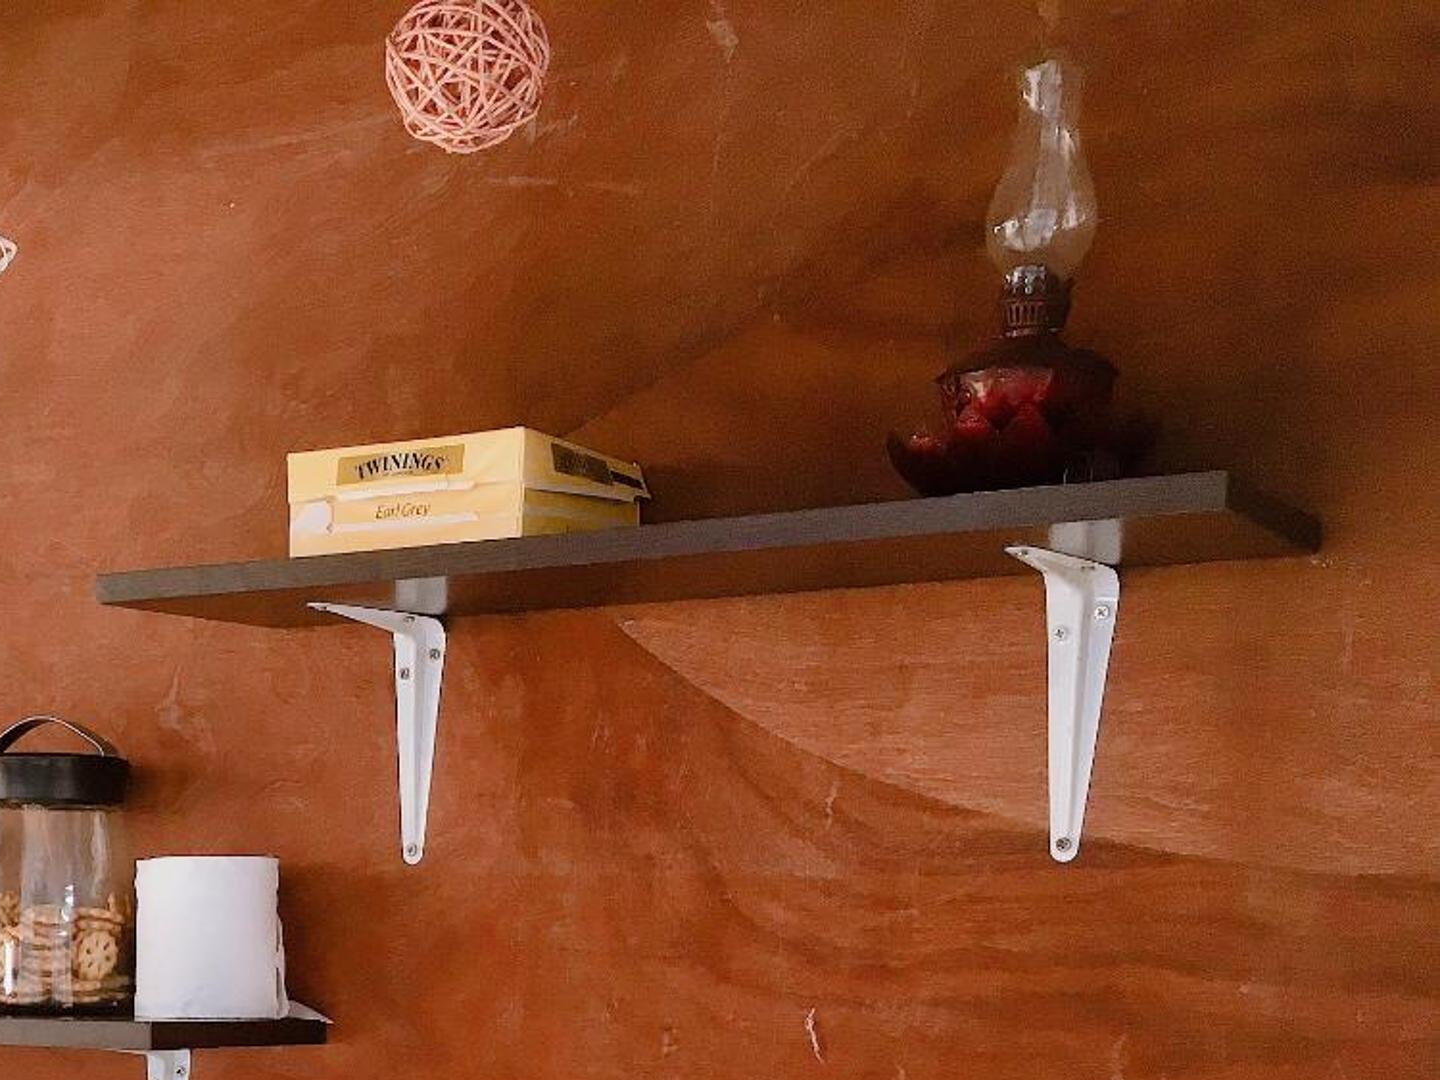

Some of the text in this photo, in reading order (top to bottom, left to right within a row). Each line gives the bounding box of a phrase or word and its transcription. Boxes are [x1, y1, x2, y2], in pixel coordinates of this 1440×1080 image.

[355, 453, 446, 480] TWININGS
[376, 503, 431, 519] Earl Grey
